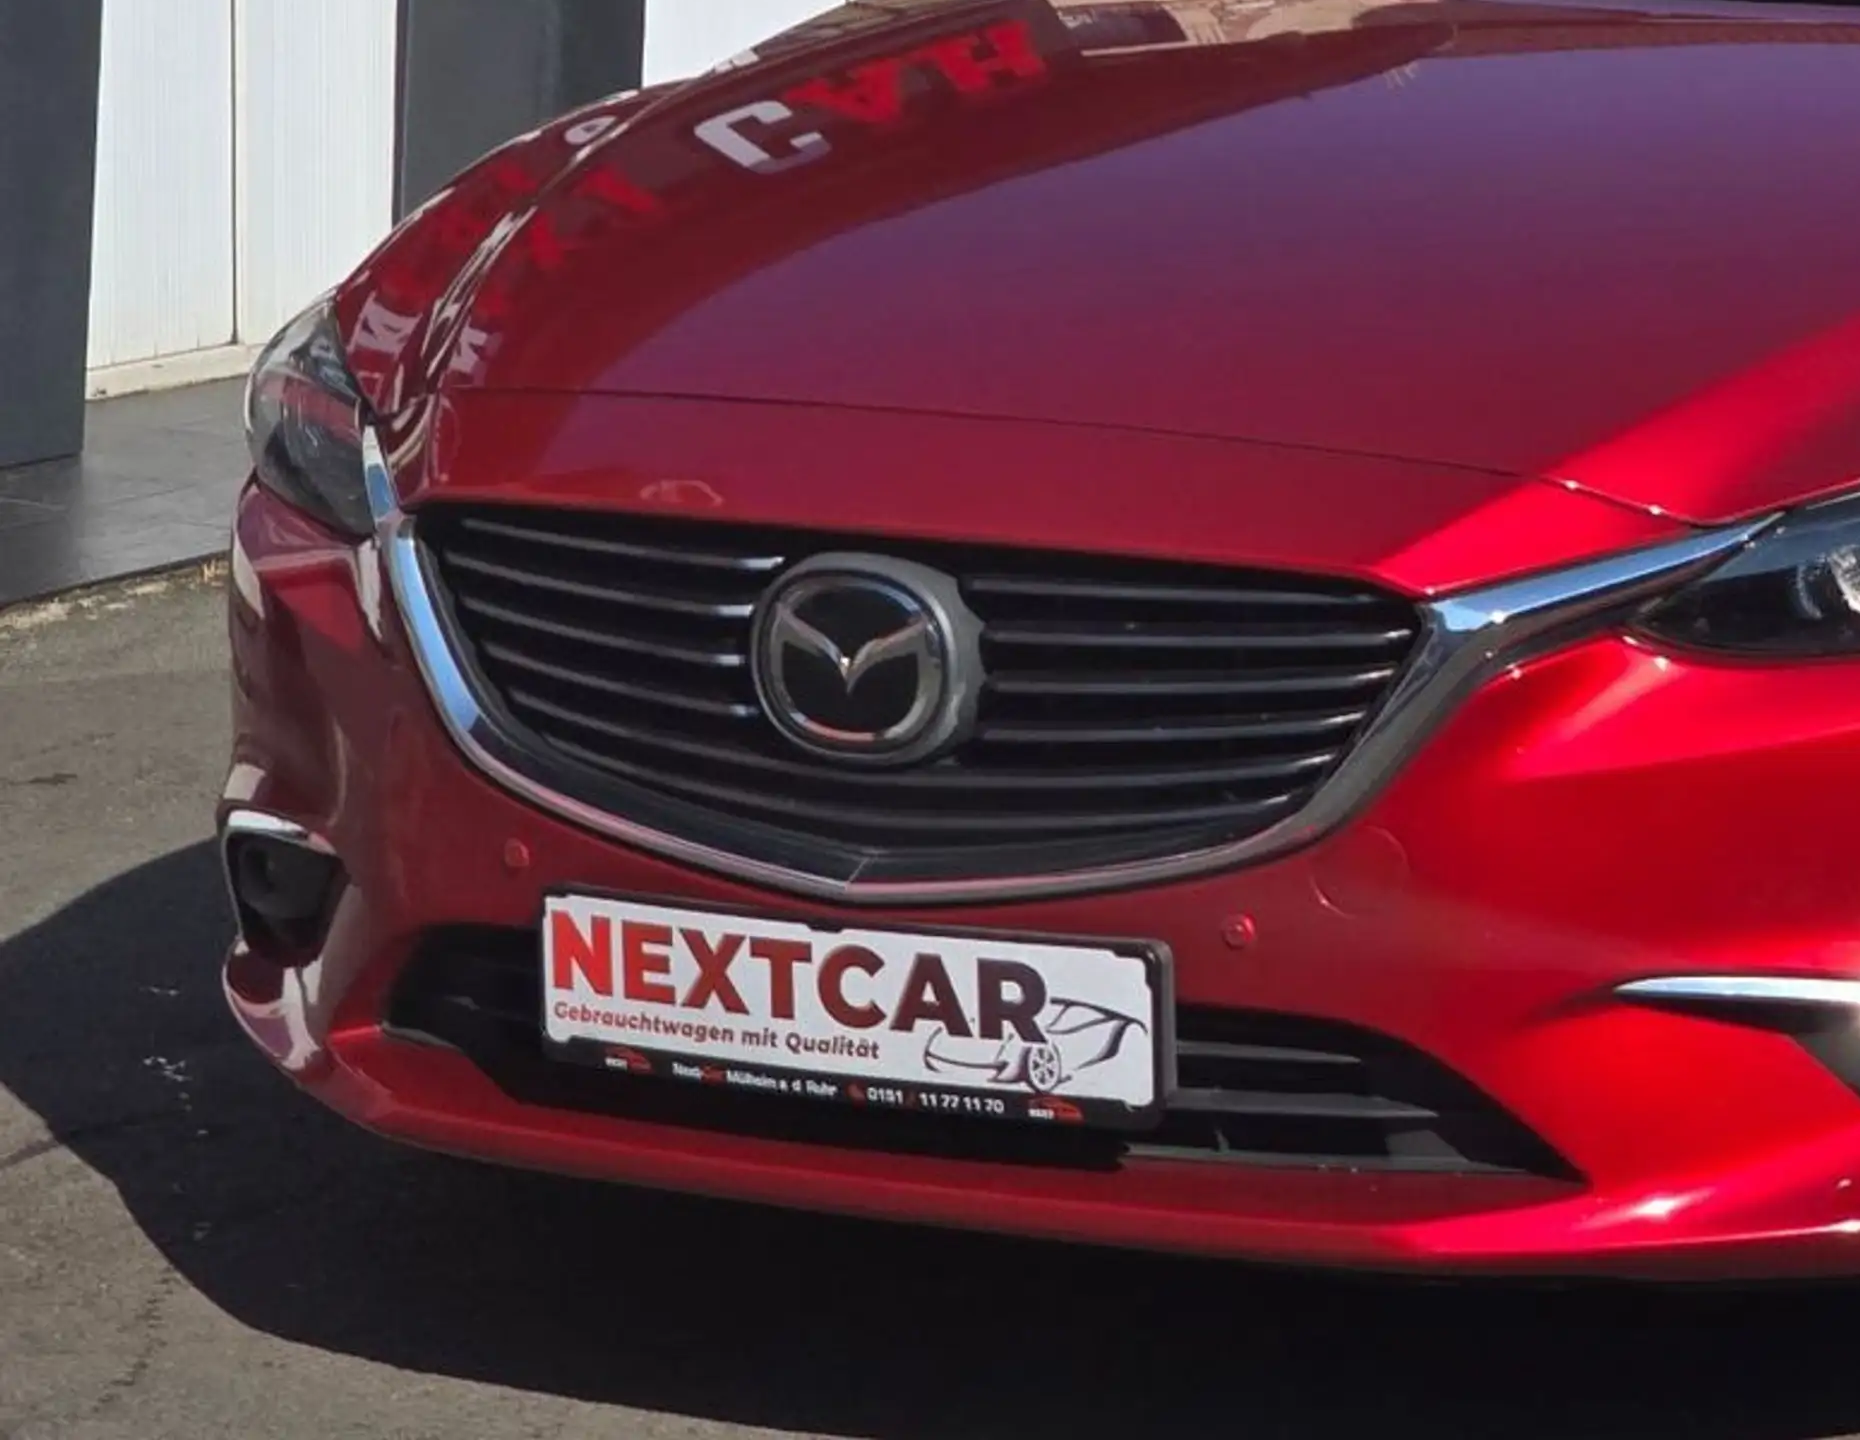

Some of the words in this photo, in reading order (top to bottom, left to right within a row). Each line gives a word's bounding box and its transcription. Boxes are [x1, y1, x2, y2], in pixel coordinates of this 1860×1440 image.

[549, 909, 1048, 1044] NEXTCAR
[552, 1000, 735, 1045] Gebrauchtwagen
[740, 1024, 779, 1049] mit
[785, 1031, 881, 1061] Qualität
